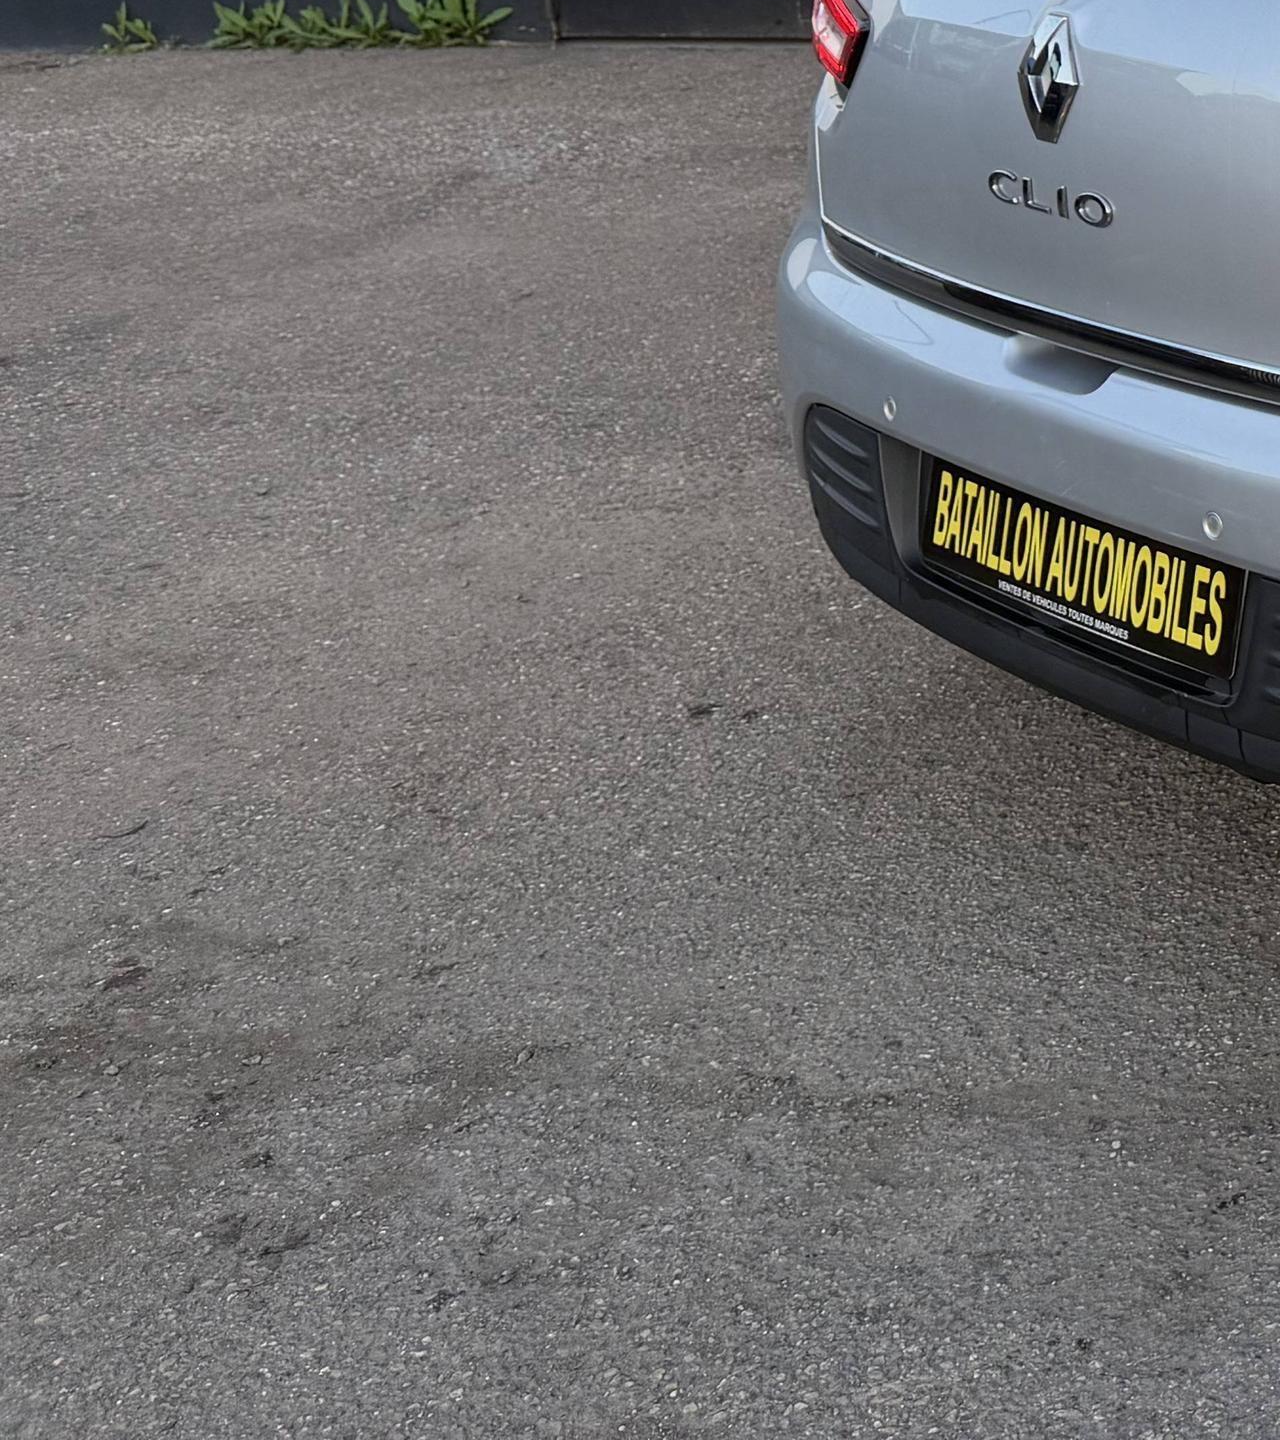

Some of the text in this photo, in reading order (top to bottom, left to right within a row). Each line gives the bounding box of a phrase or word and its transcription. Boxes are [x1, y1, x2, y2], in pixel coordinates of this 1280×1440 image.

[987, 168, 1116, 229] CLIO
[932, 470, 1226, 656] BATAILLON AUTOMOBILES
[998, 579, 1129, 640] VENTES DE VEHICULES TOUTES MARQUES
